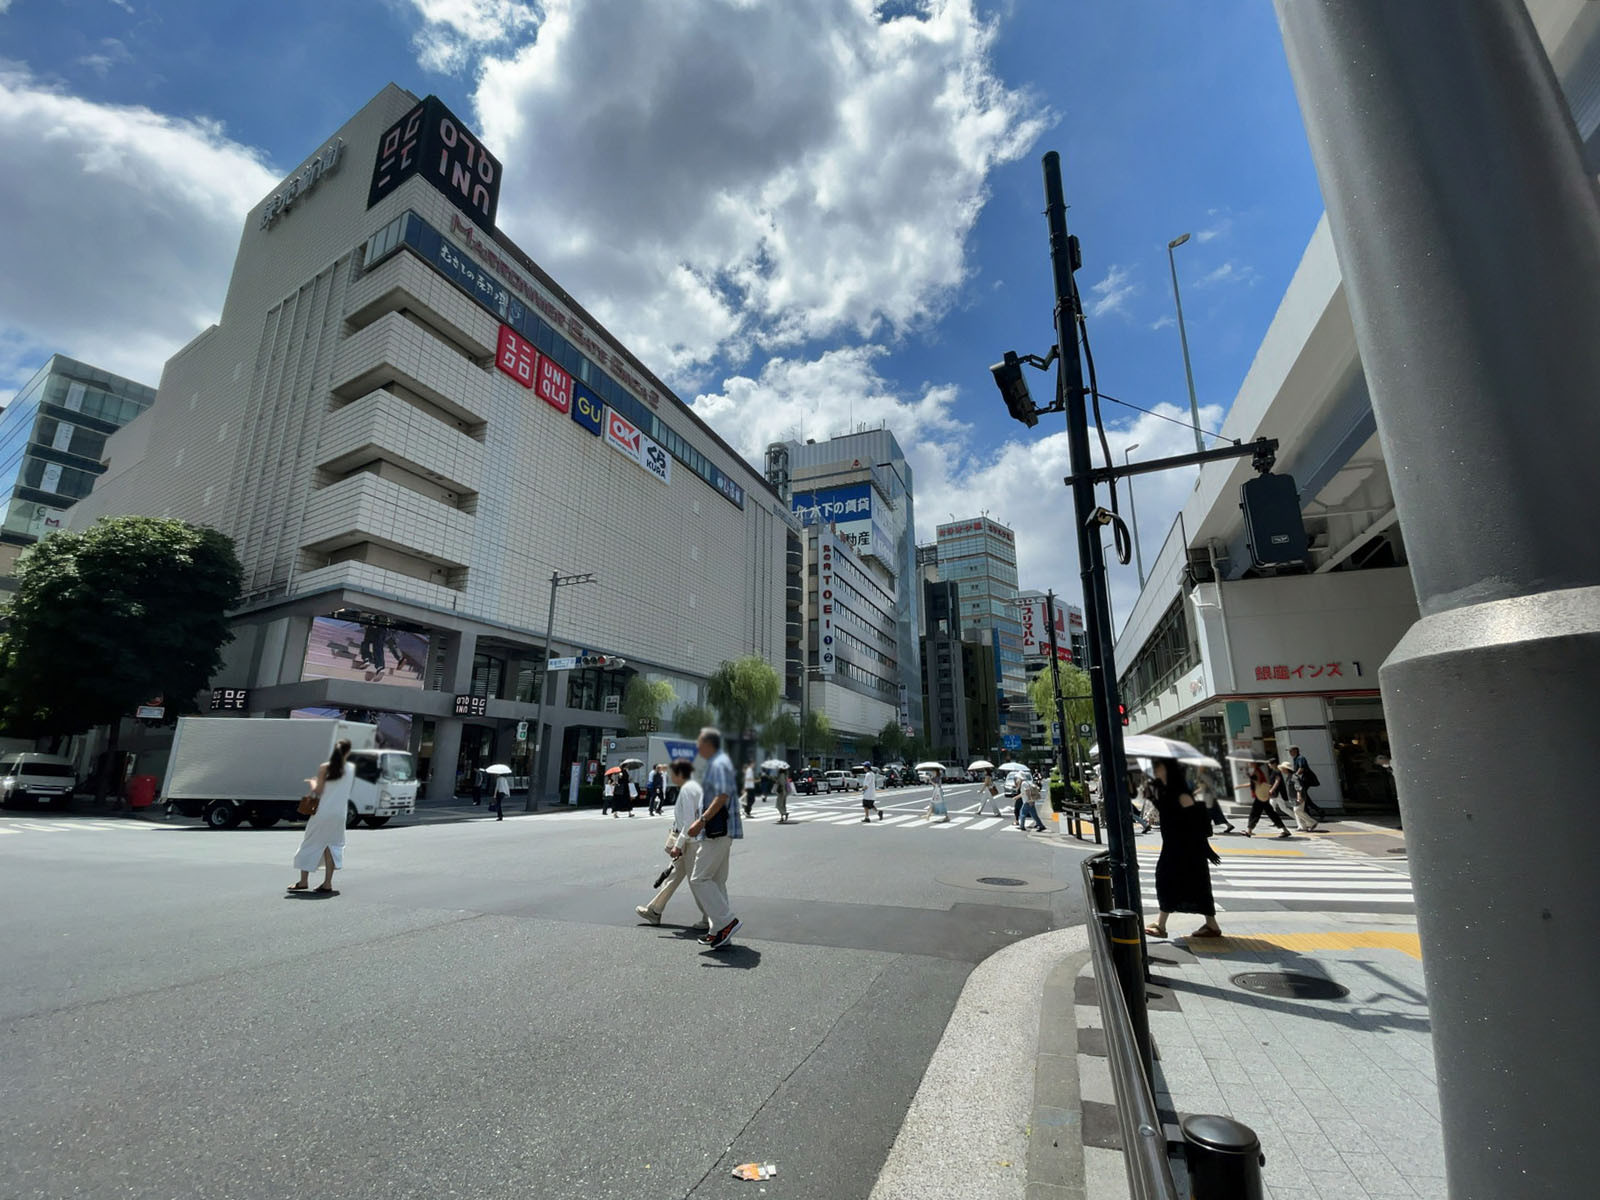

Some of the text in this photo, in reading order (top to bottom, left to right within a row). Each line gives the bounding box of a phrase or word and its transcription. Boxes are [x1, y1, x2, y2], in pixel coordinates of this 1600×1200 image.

[544, 361, 566, 388] UNI
[542, 380, 567, 405] QLO
[578, 397, 601, 423] GU
[613, 419, 641, 452] OK
[646, 459, 667, 480] KURA
[1255, 661, 1362, 681] 銀座インズ 1
